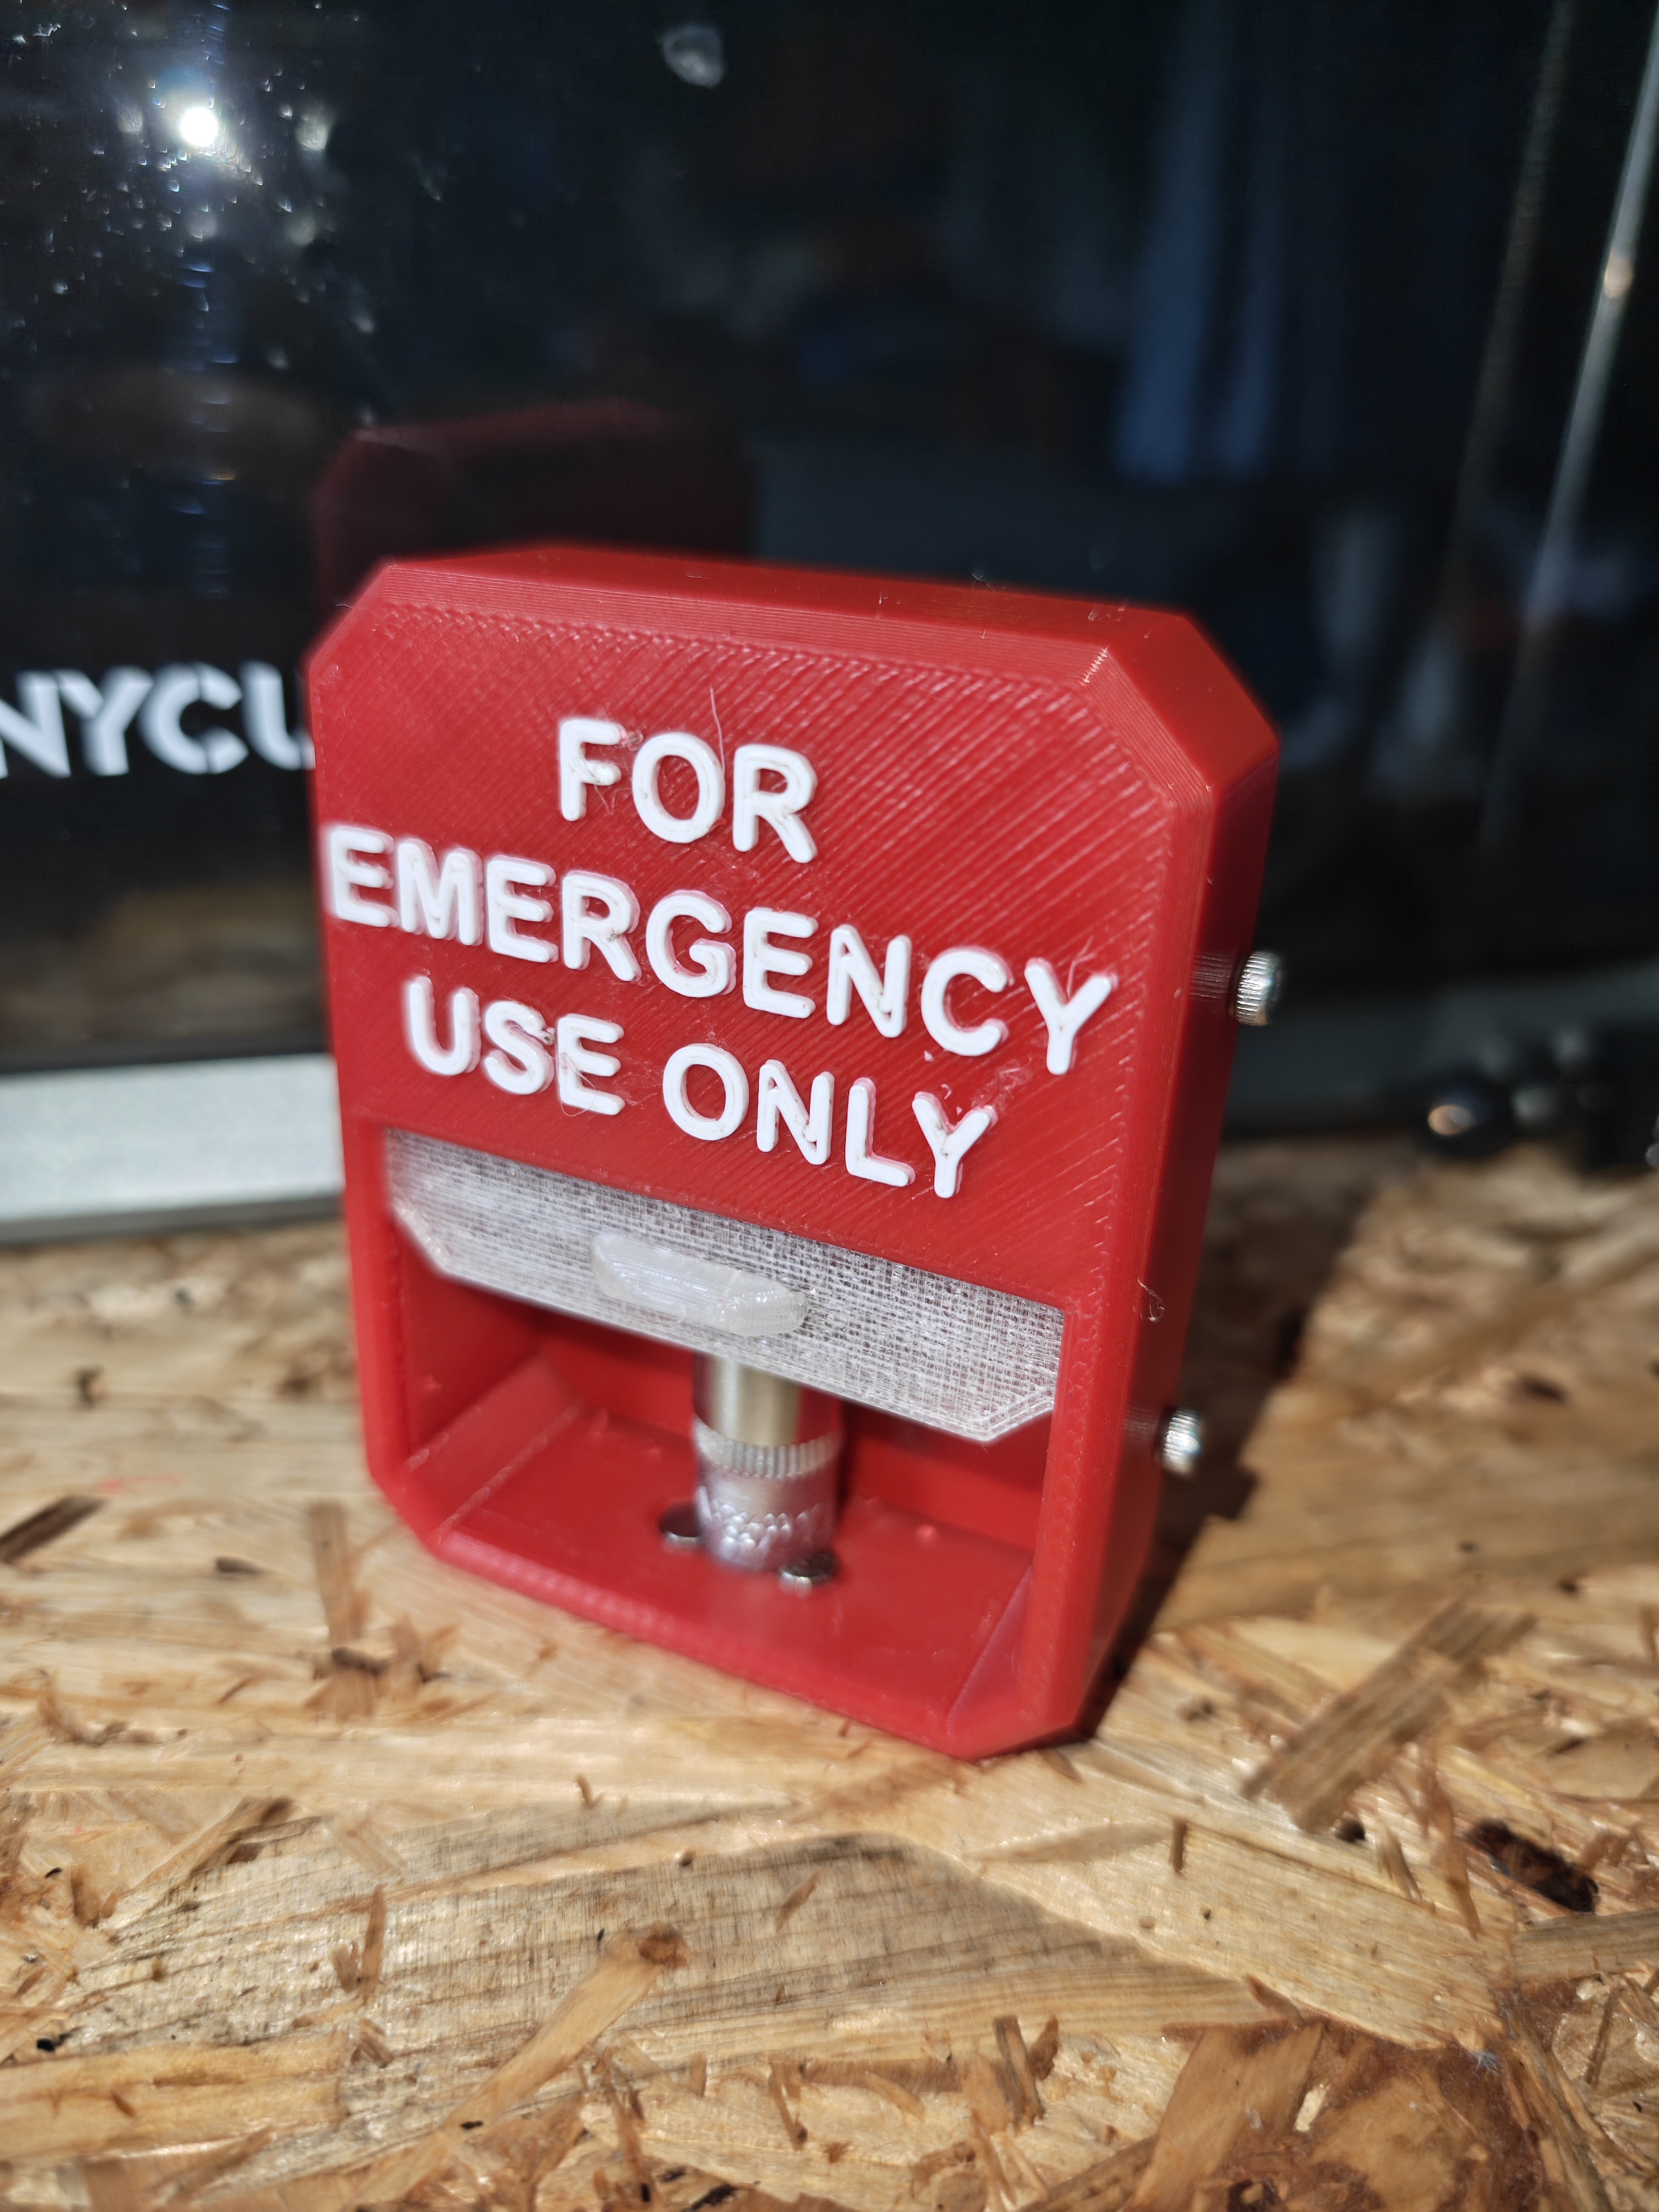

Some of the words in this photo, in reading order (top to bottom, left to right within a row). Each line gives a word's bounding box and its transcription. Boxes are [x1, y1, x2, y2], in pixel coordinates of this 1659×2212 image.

[558, 717, 818, 864] FOR
[324, 825, 1118, 1075] EMERGENCY
[404, 976, 625, 1116] USE
[662, 1043, 997, 1198] ONLY
